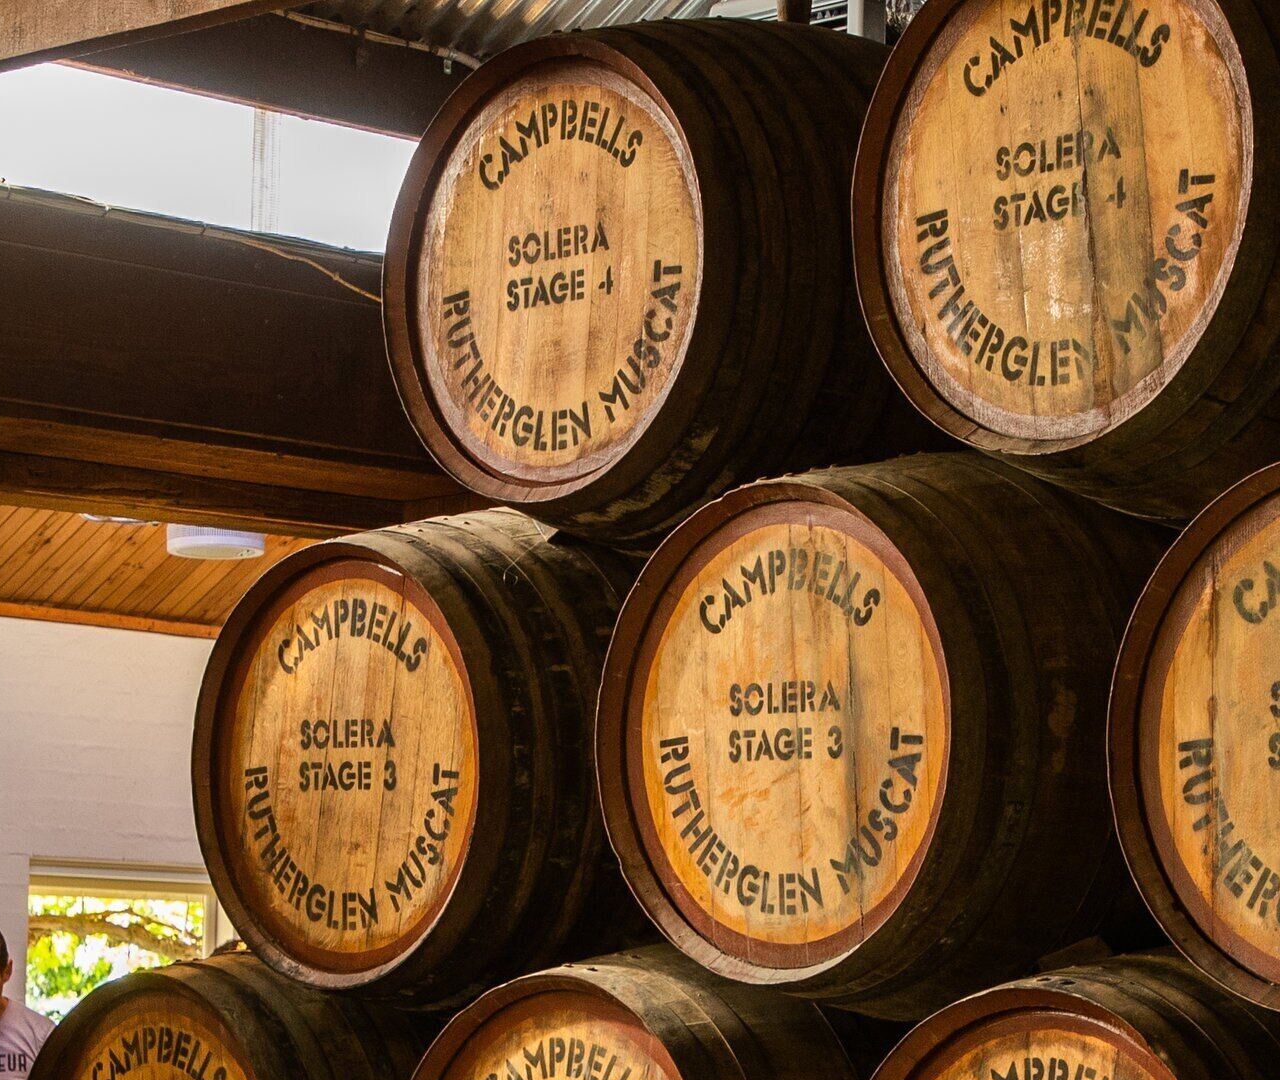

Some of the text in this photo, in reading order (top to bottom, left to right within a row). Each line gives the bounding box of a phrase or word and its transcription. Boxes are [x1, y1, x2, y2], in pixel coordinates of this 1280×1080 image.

[963, 0, 1170, 96] CAMPBELLS
[479, 100, 643, 191] CAMPBELLS
[996, 127, 1121, 182] SOLERA
[1106, 175, 1126, 209] 4
[508, 222, 610, 267] SOLERA
[507, 266, 614, 311] STAGE 4
[916, 169, 1215, 387] RUTHERGLEN MUSCAT
[442, 260, 682, 451] RUTHERGLEN MUSCAT
[699, 548, 881, 634] CAMPBELLS
[278, 598, 428, 674] CAMPBELLS
[729, 680, 841, 717] SOLERA
[300, 719, 396, 750] SOLERA
[729, 725, 843, 763] STAGE 3
[299, 761, 396, 792] STAGE 3
[245, 763, 459, 930] RUTHERGLEN MUSCAT
[660, 727, 923, 916] RUTHERGLEN MUSCAT
